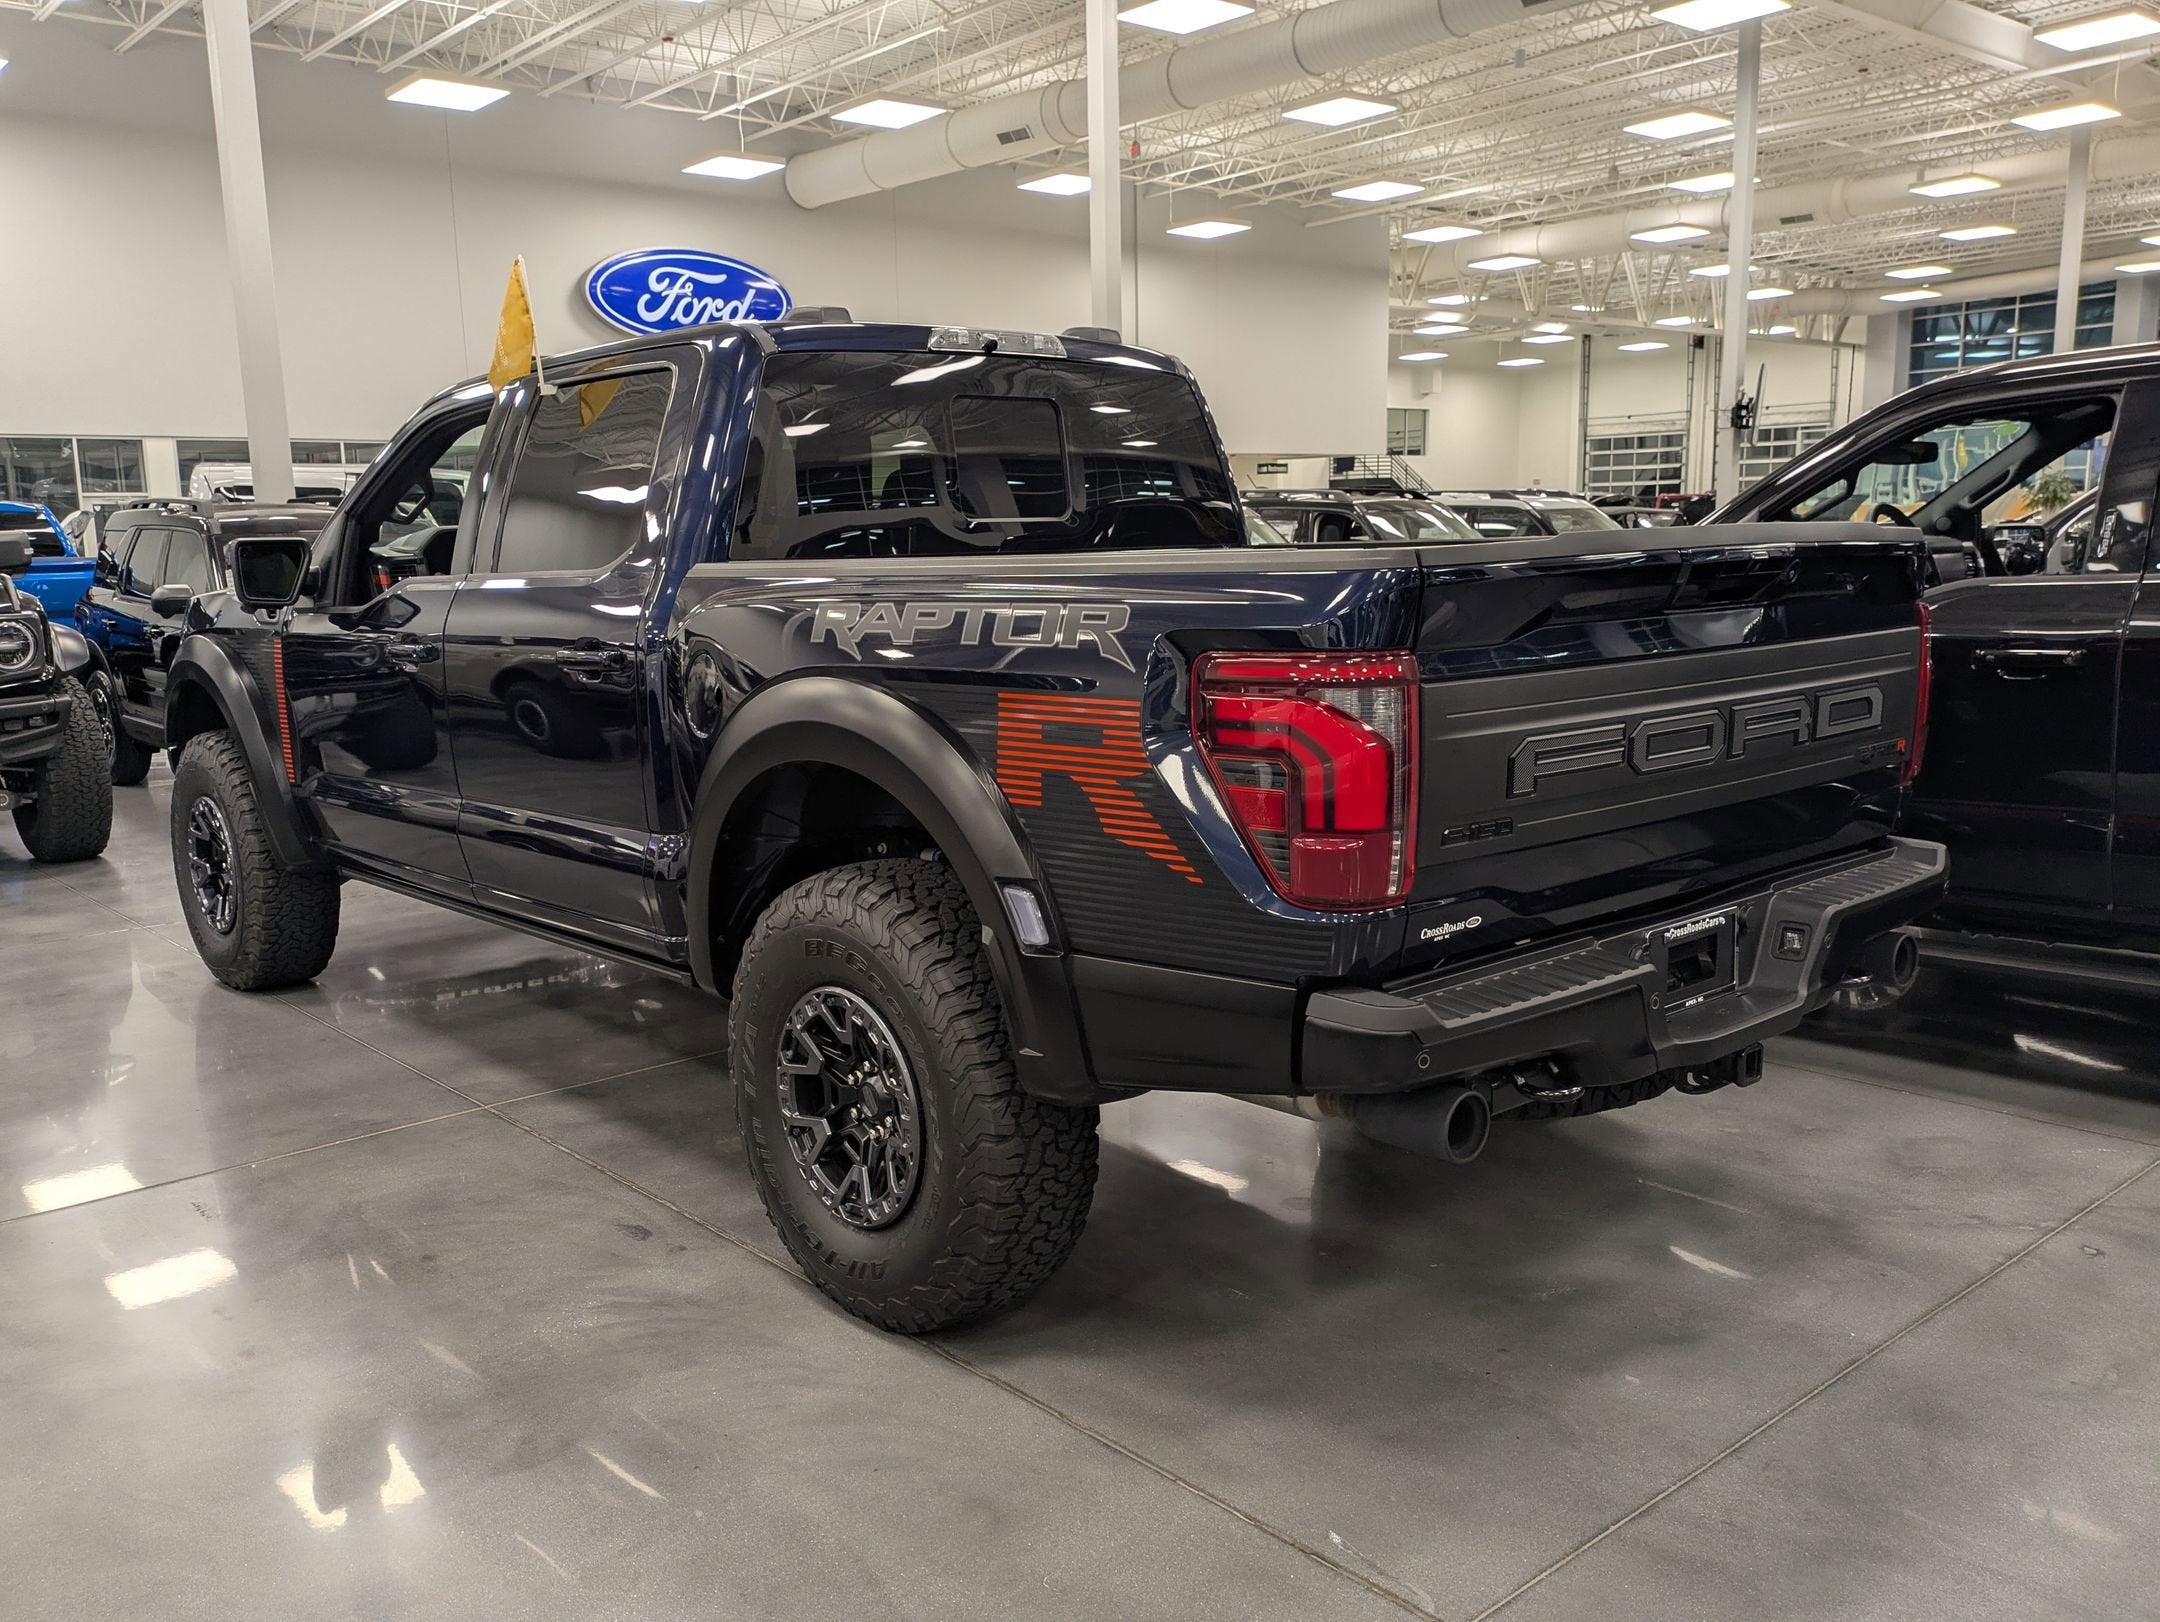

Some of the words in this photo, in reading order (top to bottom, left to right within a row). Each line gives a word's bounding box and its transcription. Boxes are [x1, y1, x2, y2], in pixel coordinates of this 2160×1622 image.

[637, 266, 760, 324] Ford
[810, 601, 1136, 673] RAPTOR
[1506, 682, 1886, 799] FORD
